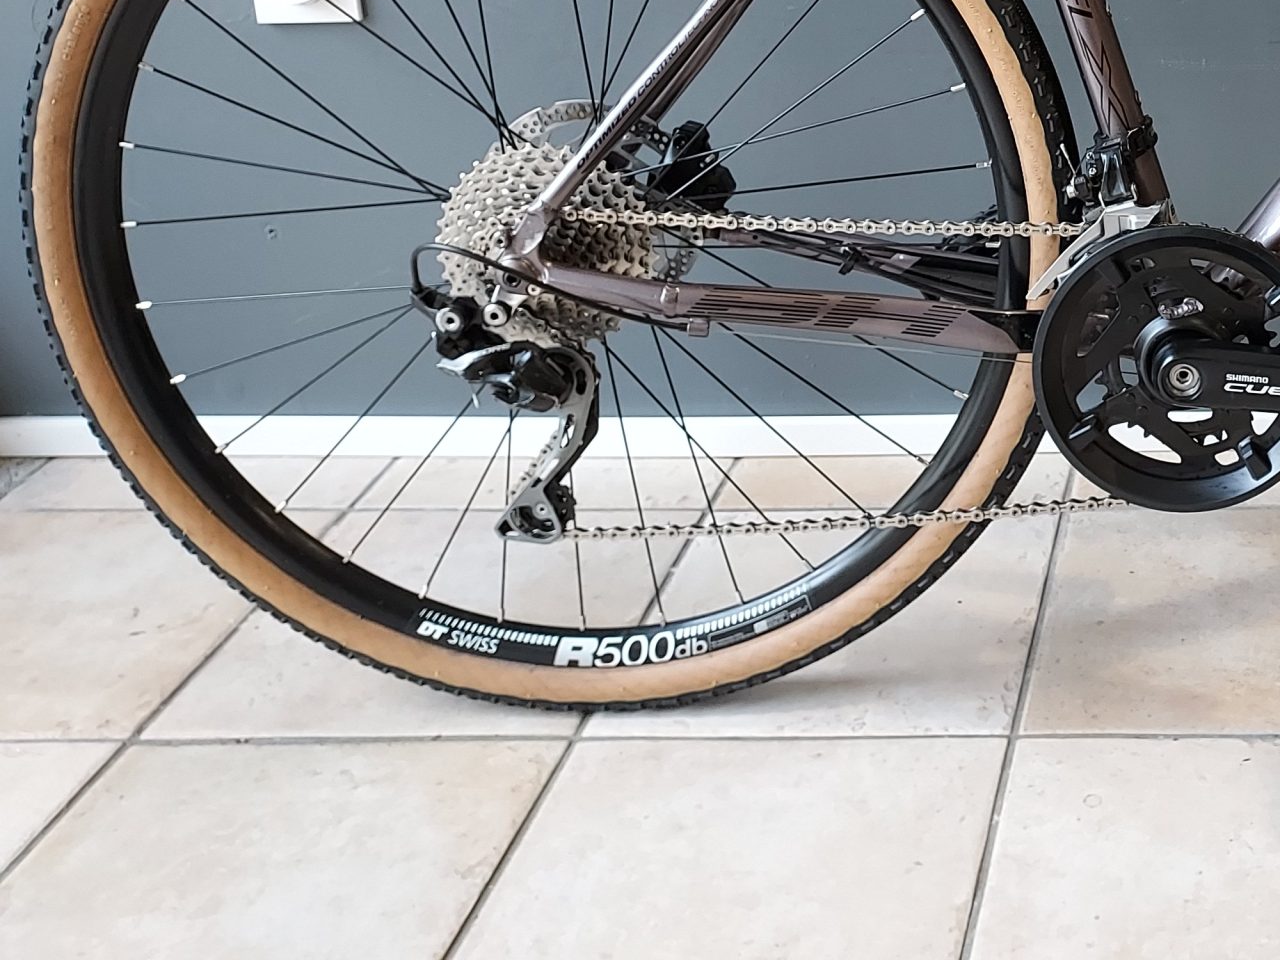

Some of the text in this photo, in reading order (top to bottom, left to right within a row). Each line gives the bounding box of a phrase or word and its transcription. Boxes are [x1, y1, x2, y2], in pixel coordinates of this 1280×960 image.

[577, 96, 637, 169] OPTIMIZED
[1226, 373, 1269, 384] SHIMANO
[416, 620, 500, 654] DT SWISS
